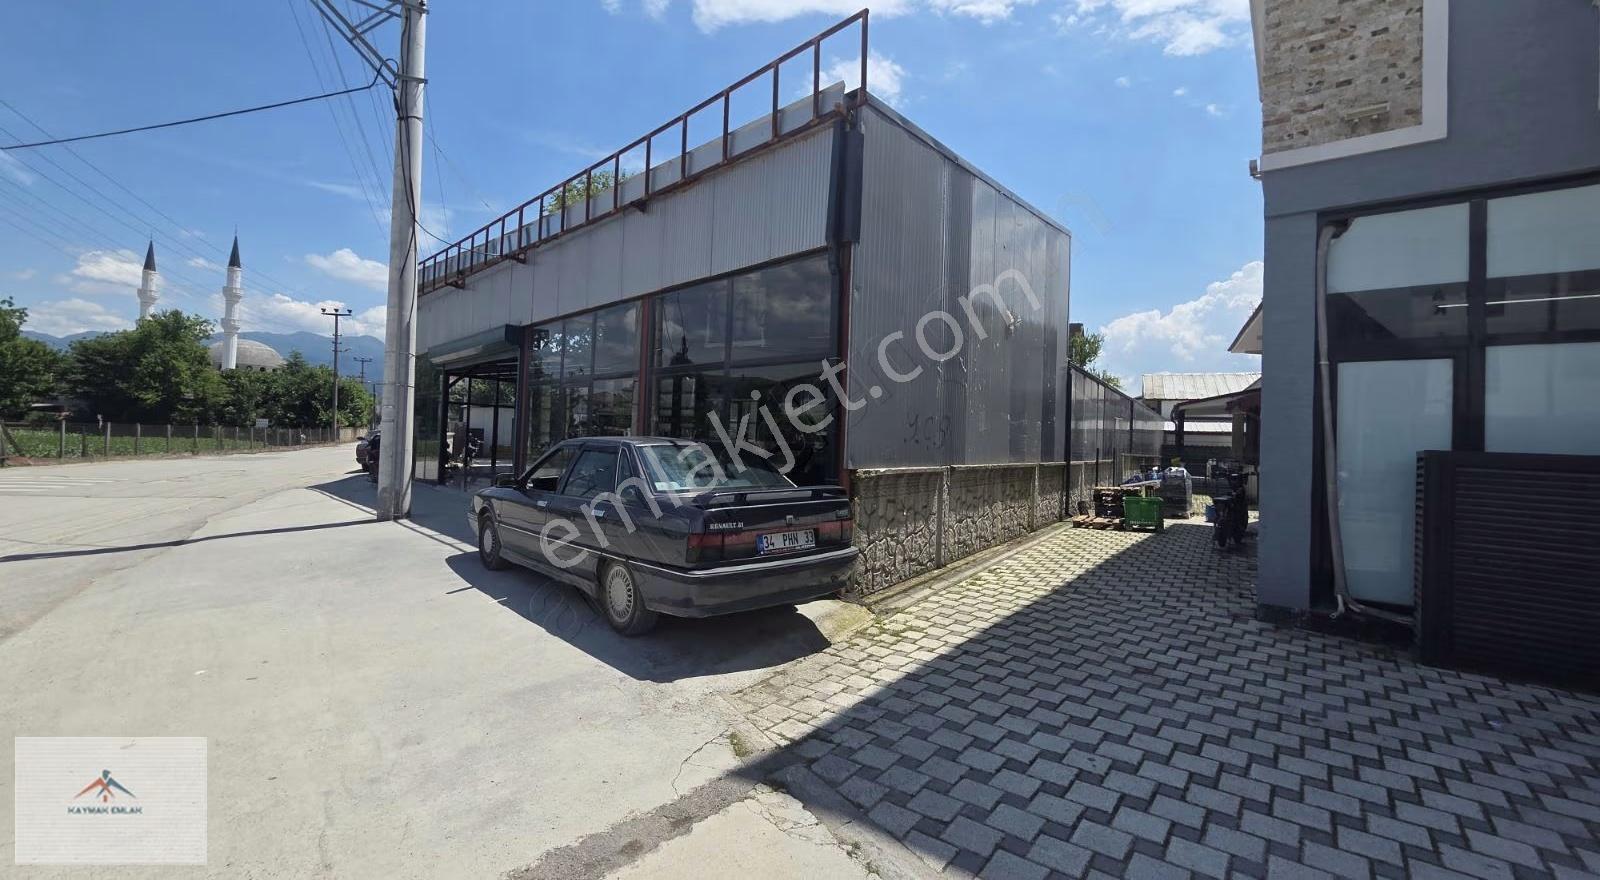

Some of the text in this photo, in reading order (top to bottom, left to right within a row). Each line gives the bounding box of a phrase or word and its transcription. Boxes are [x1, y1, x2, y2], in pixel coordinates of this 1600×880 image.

[709, 521, 737, 529] RENAULT
[763, 535, 775, 549] 34
[782, 532, 799, 547] PHN
[804, 531, 814, 543] 33
